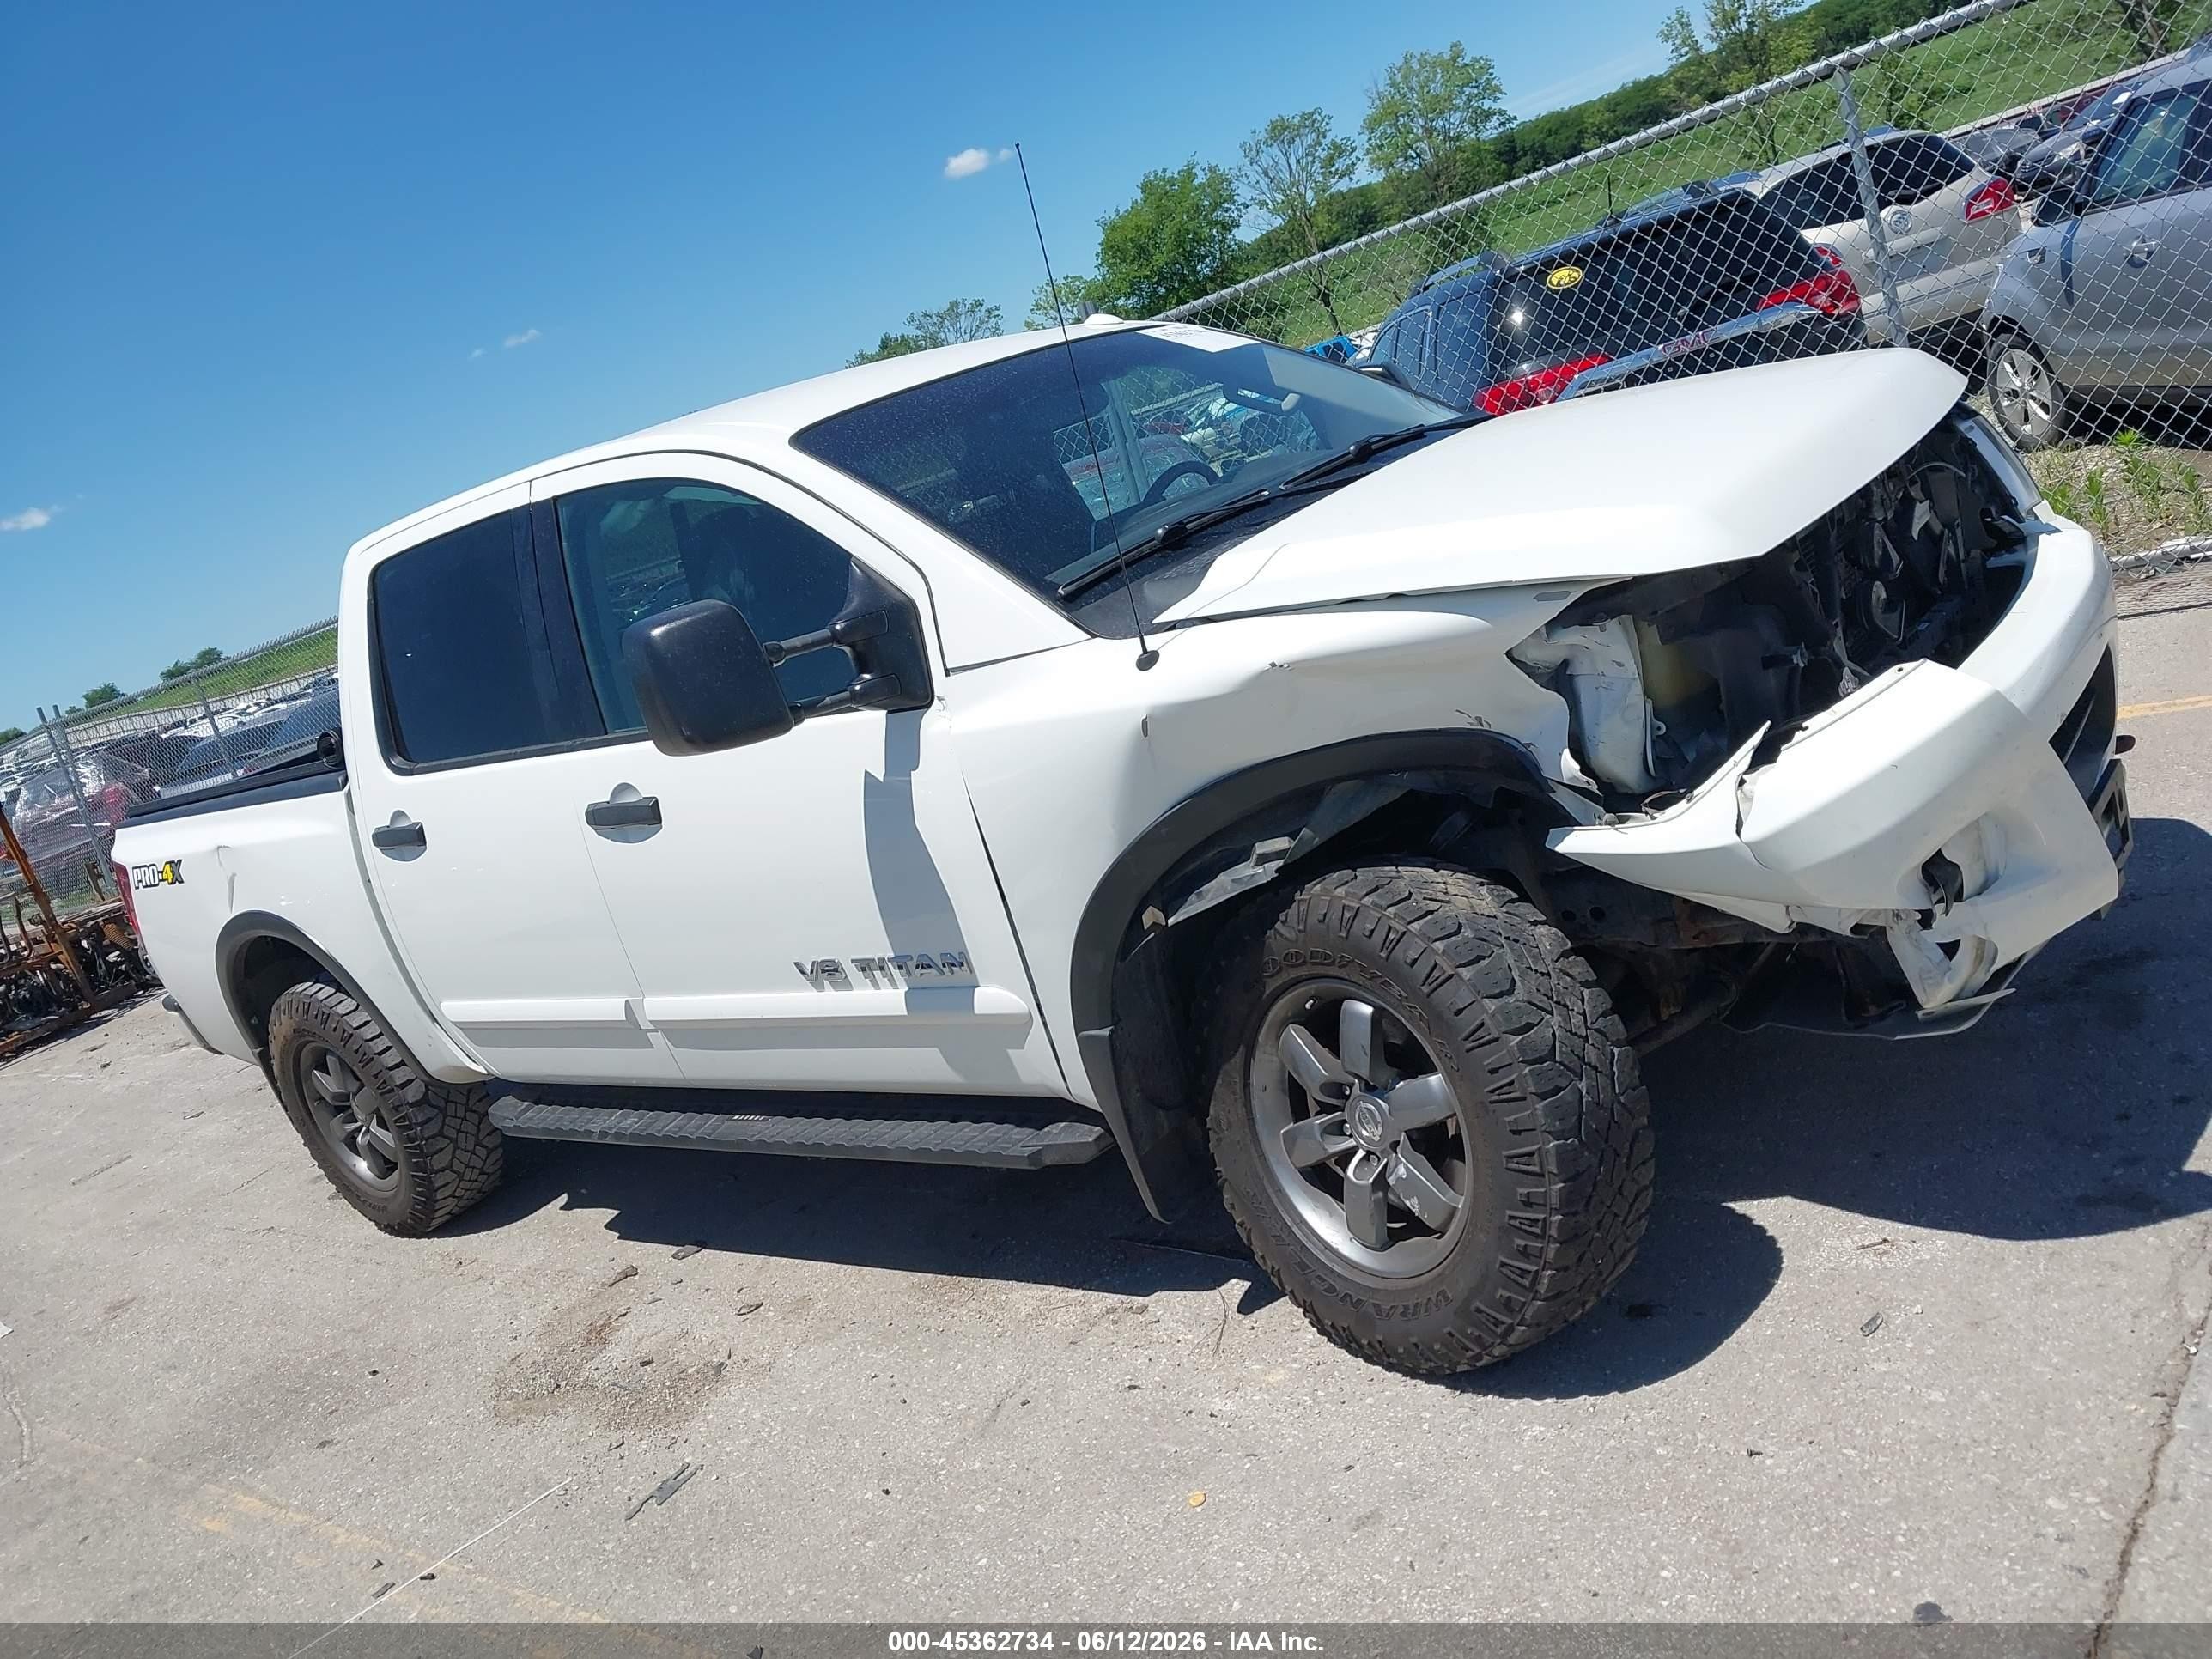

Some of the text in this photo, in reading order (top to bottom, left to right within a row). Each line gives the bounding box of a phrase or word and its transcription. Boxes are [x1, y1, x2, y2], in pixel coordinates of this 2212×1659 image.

[1661, 327, 1719, 355] GMC
[132, 860, 185, 890] PRO-4X
[793, 951, 973, 981] V8 TITAN
[1261, 947, 1460, 1073] OODYEAR
